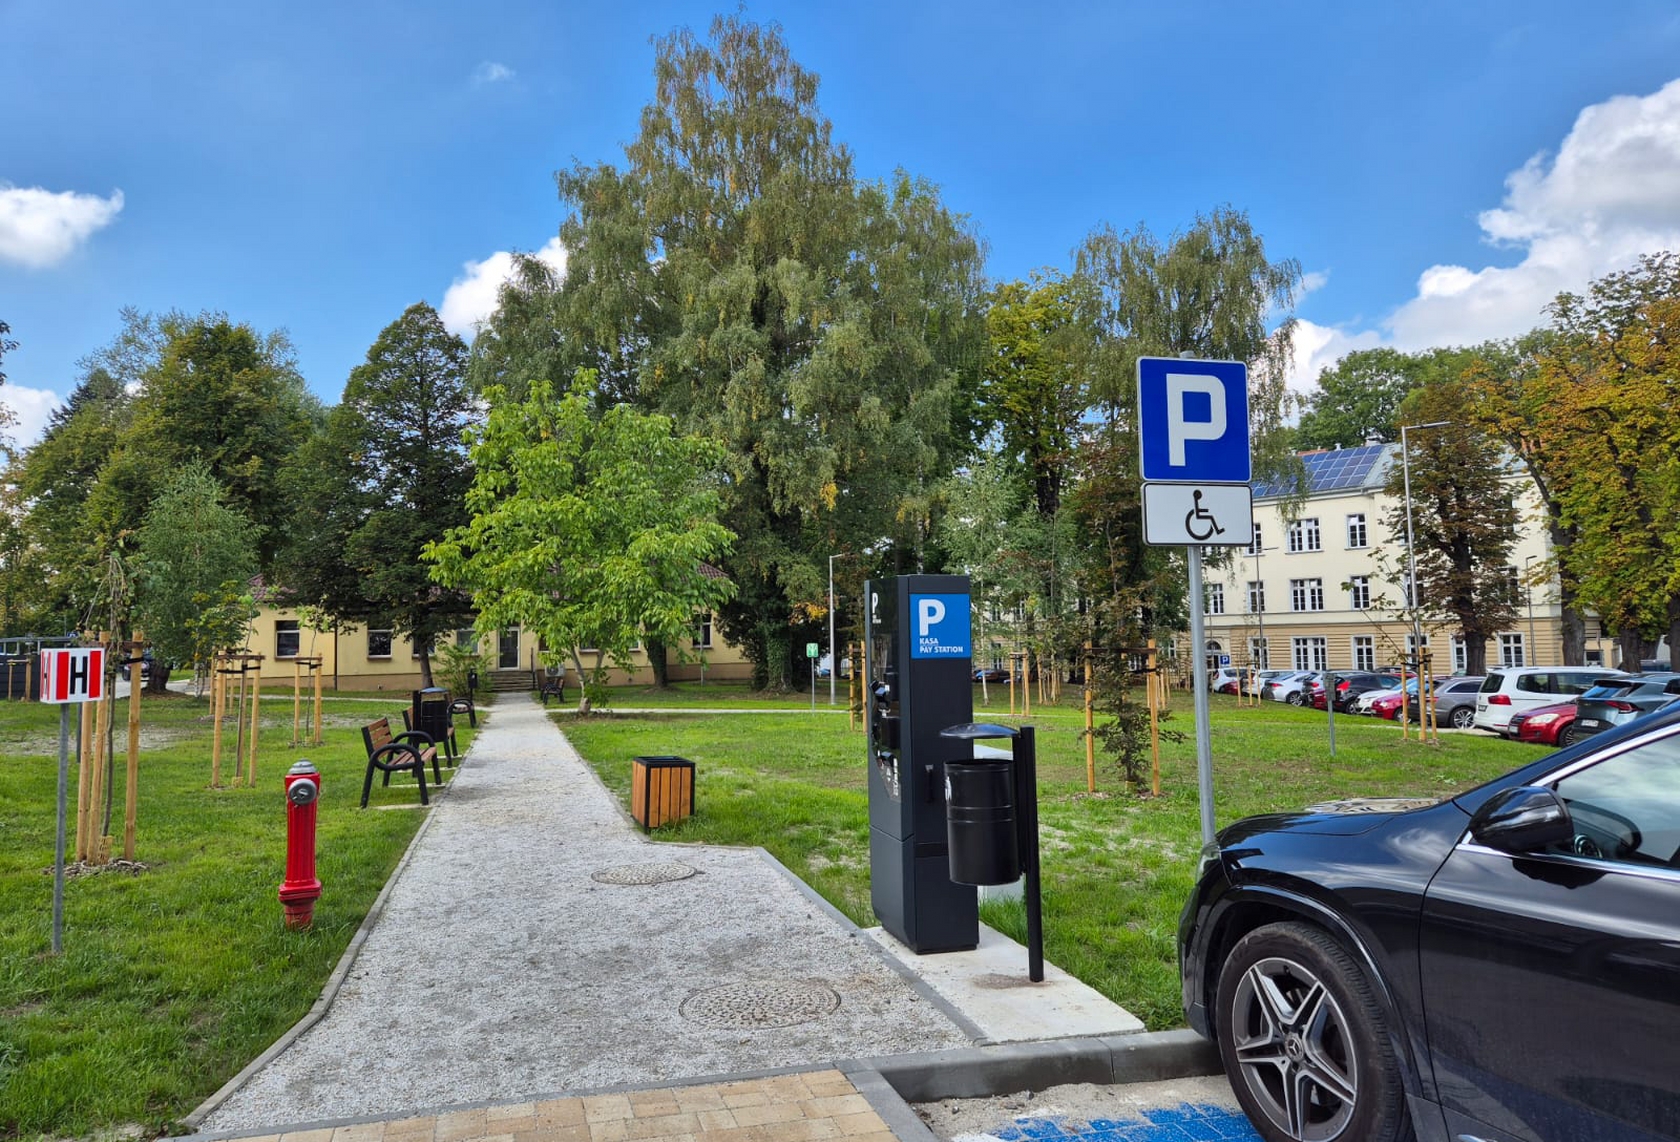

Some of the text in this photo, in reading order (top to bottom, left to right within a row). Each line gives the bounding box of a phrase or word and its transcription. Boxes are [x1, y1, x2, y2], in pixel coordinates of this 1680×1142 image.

[1166, 373, 1227, 467] P
[872, 592, 879, 614] P
[918, 599, 946, 636] P
[919, 637, 939, 645] KASA
[919, 645, 933, 653] PAY
[69, 656, 88, 695] H
